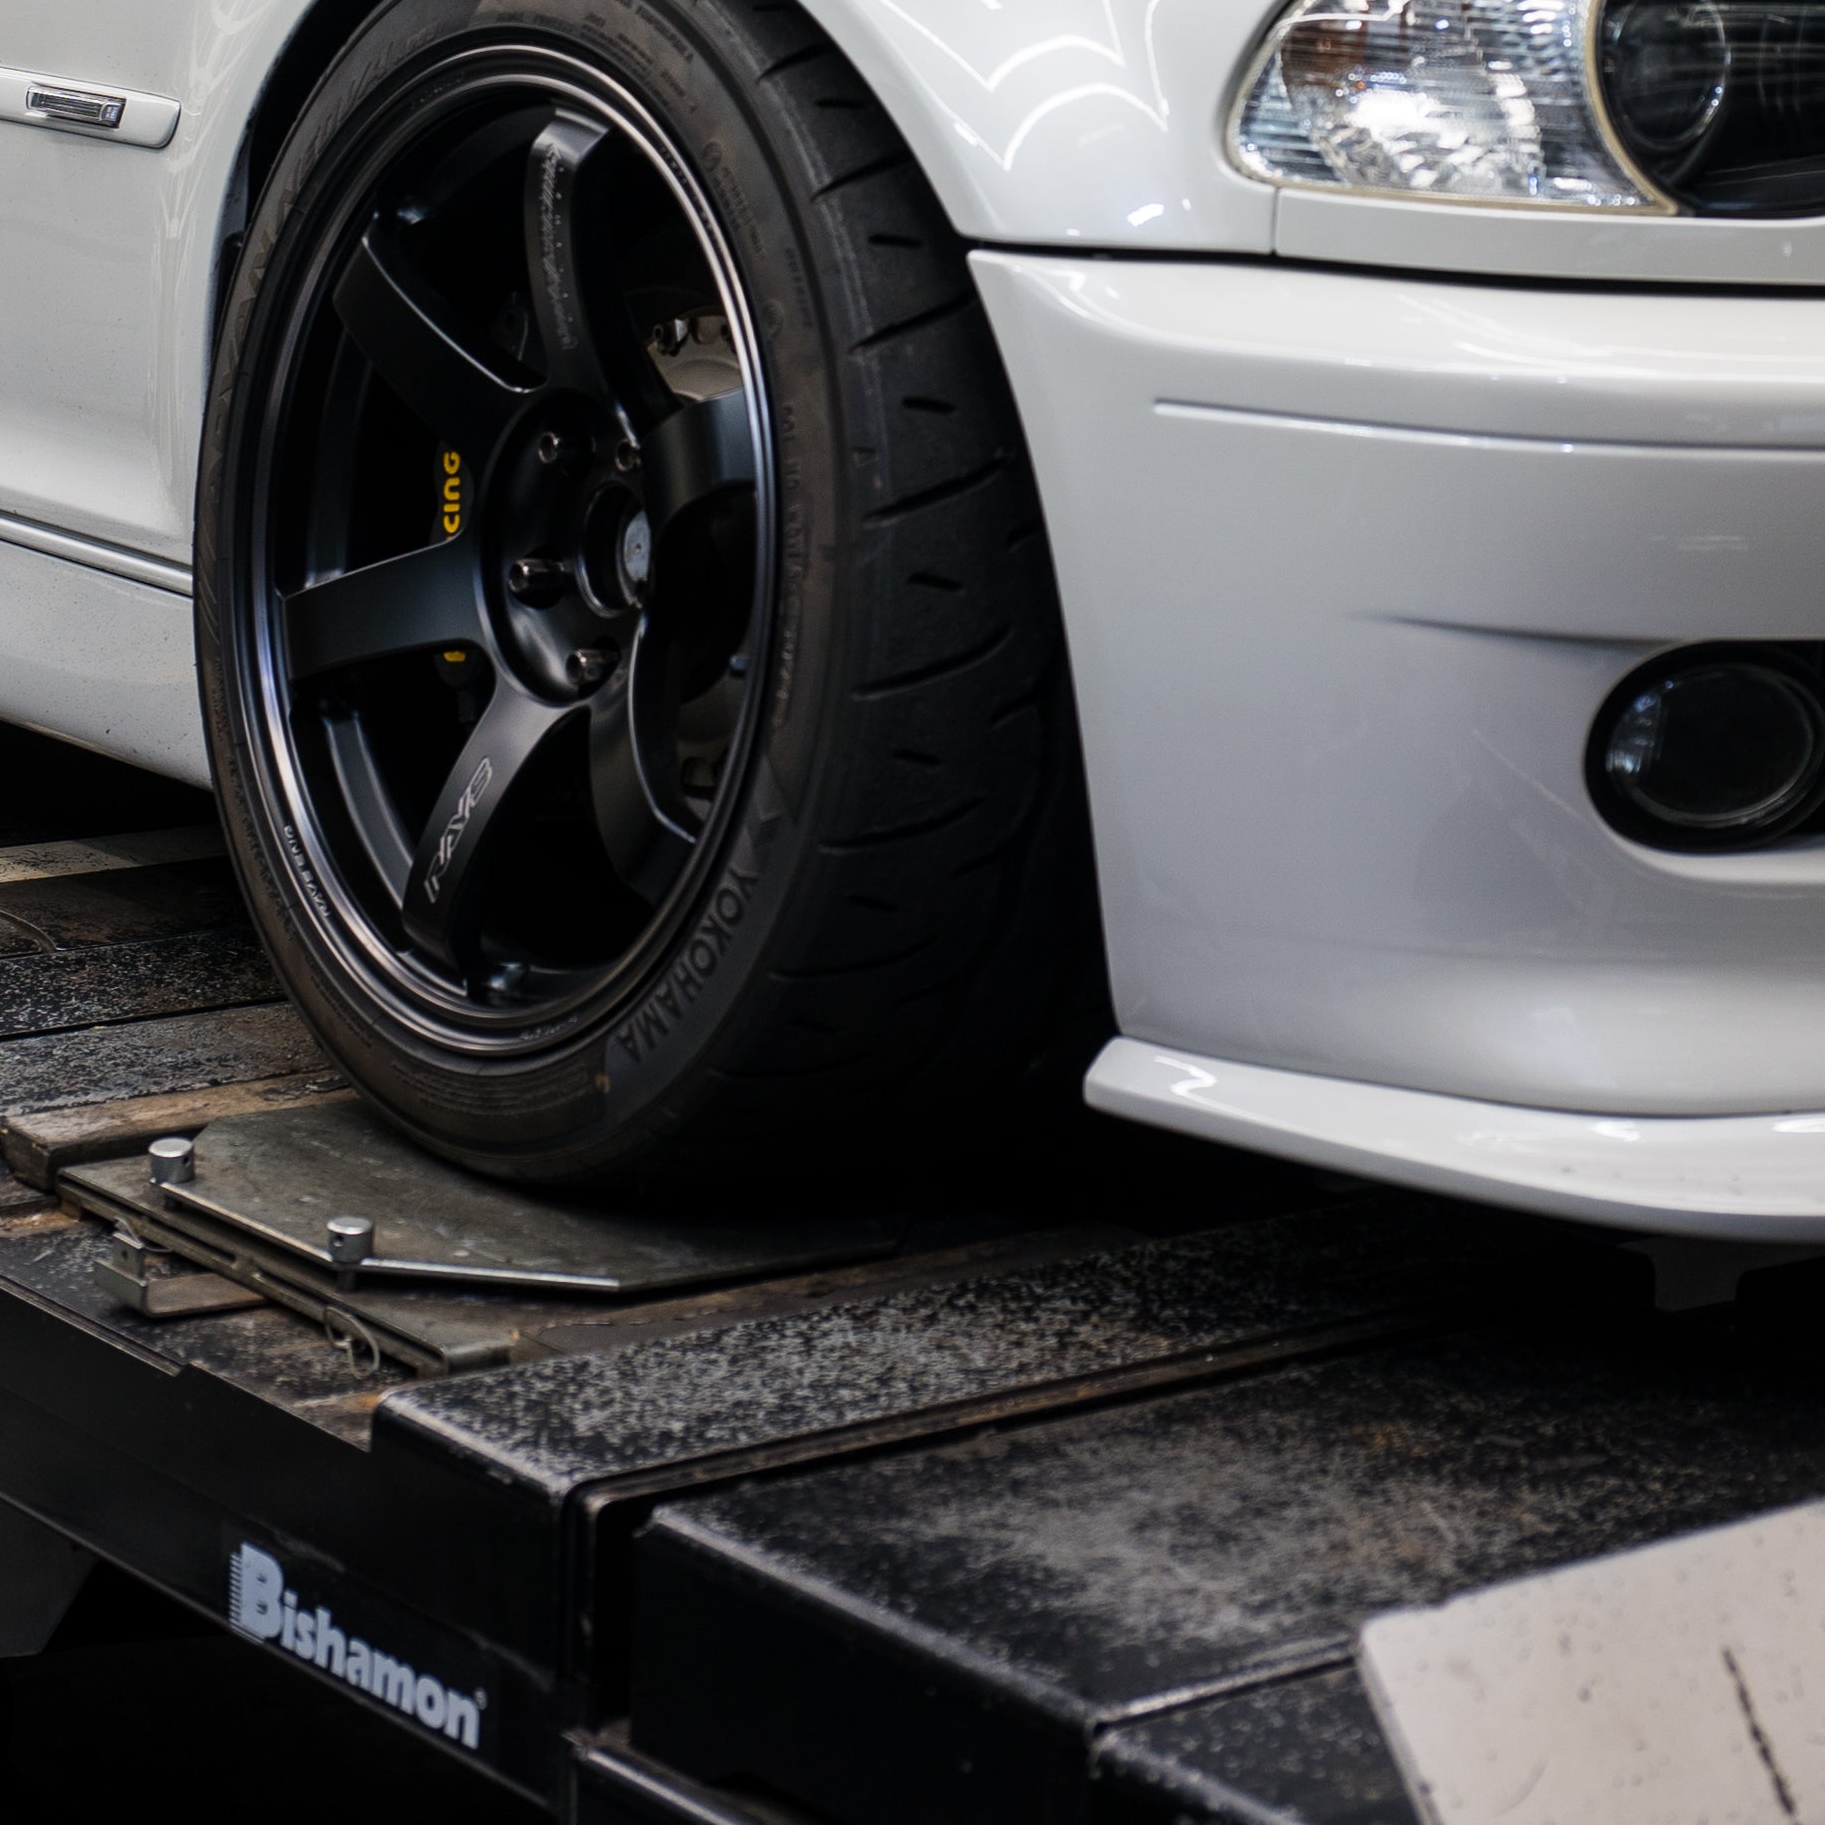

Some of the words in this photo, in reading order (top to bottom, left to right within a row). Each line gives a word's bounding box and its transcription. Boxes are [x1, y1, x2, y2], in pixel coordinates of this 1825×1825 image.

[423, 757, 493, 904] RAYS
[616, 866, 759, 1064] YOKOHAMA
[229, 1542, 481, 1750] Bishamon
